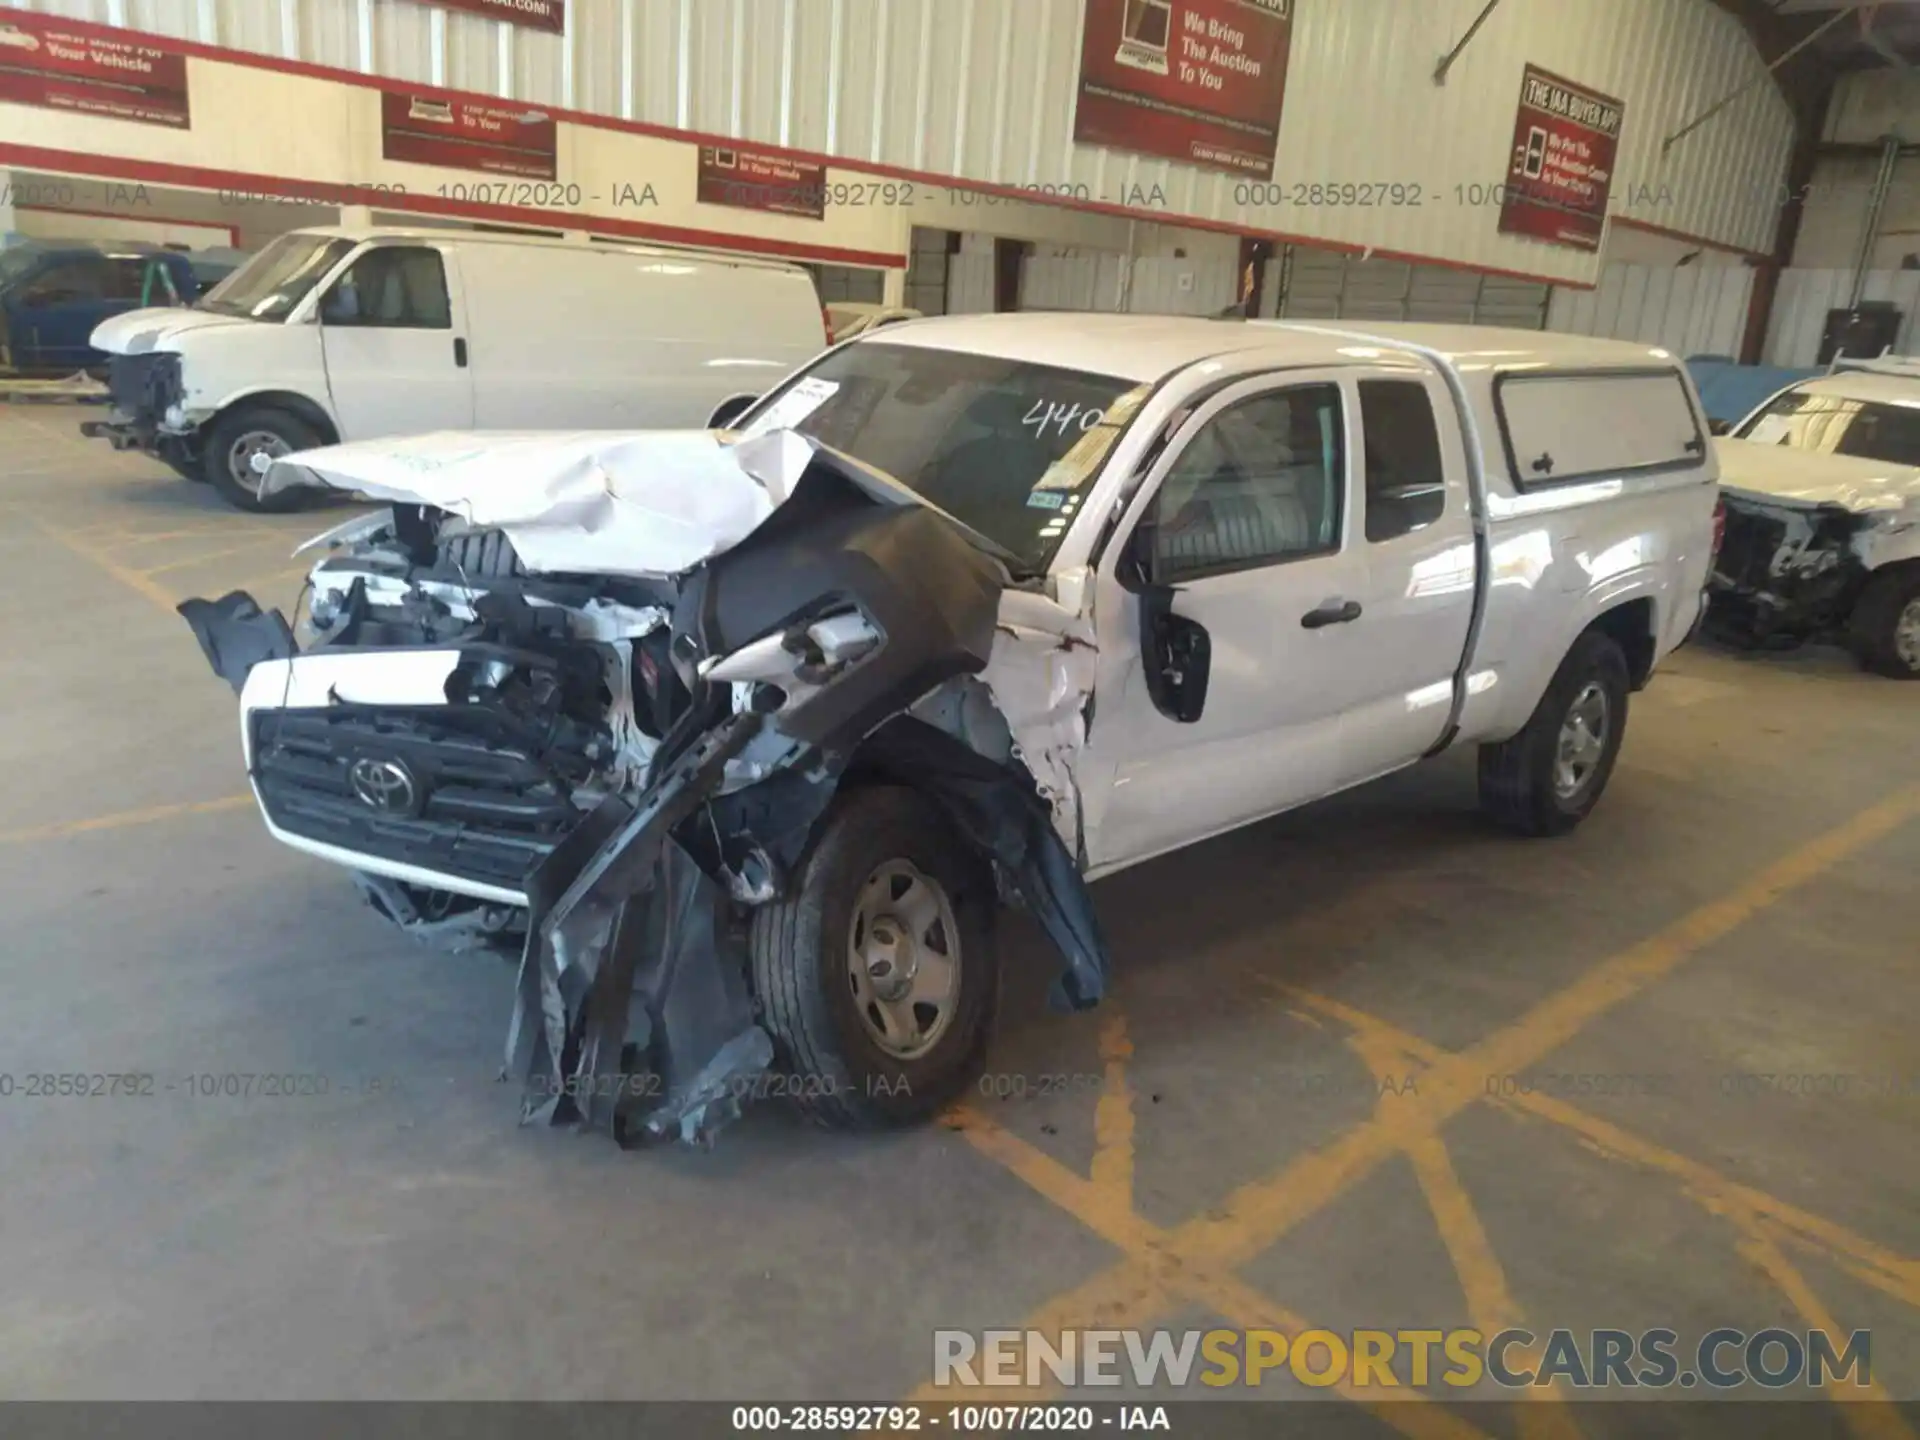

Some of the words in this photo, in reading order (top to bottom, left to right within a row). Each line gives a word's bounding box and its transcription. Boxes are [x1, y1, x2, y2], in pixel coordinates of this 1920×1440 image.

[1183, 10, 1206, 34] We
[1208, 18, 1245, 50] Bring
[45, 41, 86, 61] Your
[90, 49, 152, 73] Vehicle
[1178, 61, 1196, 82] To
[1199, 67, 1223, 91] You
[1181, 36, 1207, 61] The
[1209, 44, 1261, 77] Auction
[462, 114, 476, 128] To
[1527, 79, 1551, 107] THE
[1568, 95, 1602, 125] BUYER
[1021, 398, 1105, 440] 440
